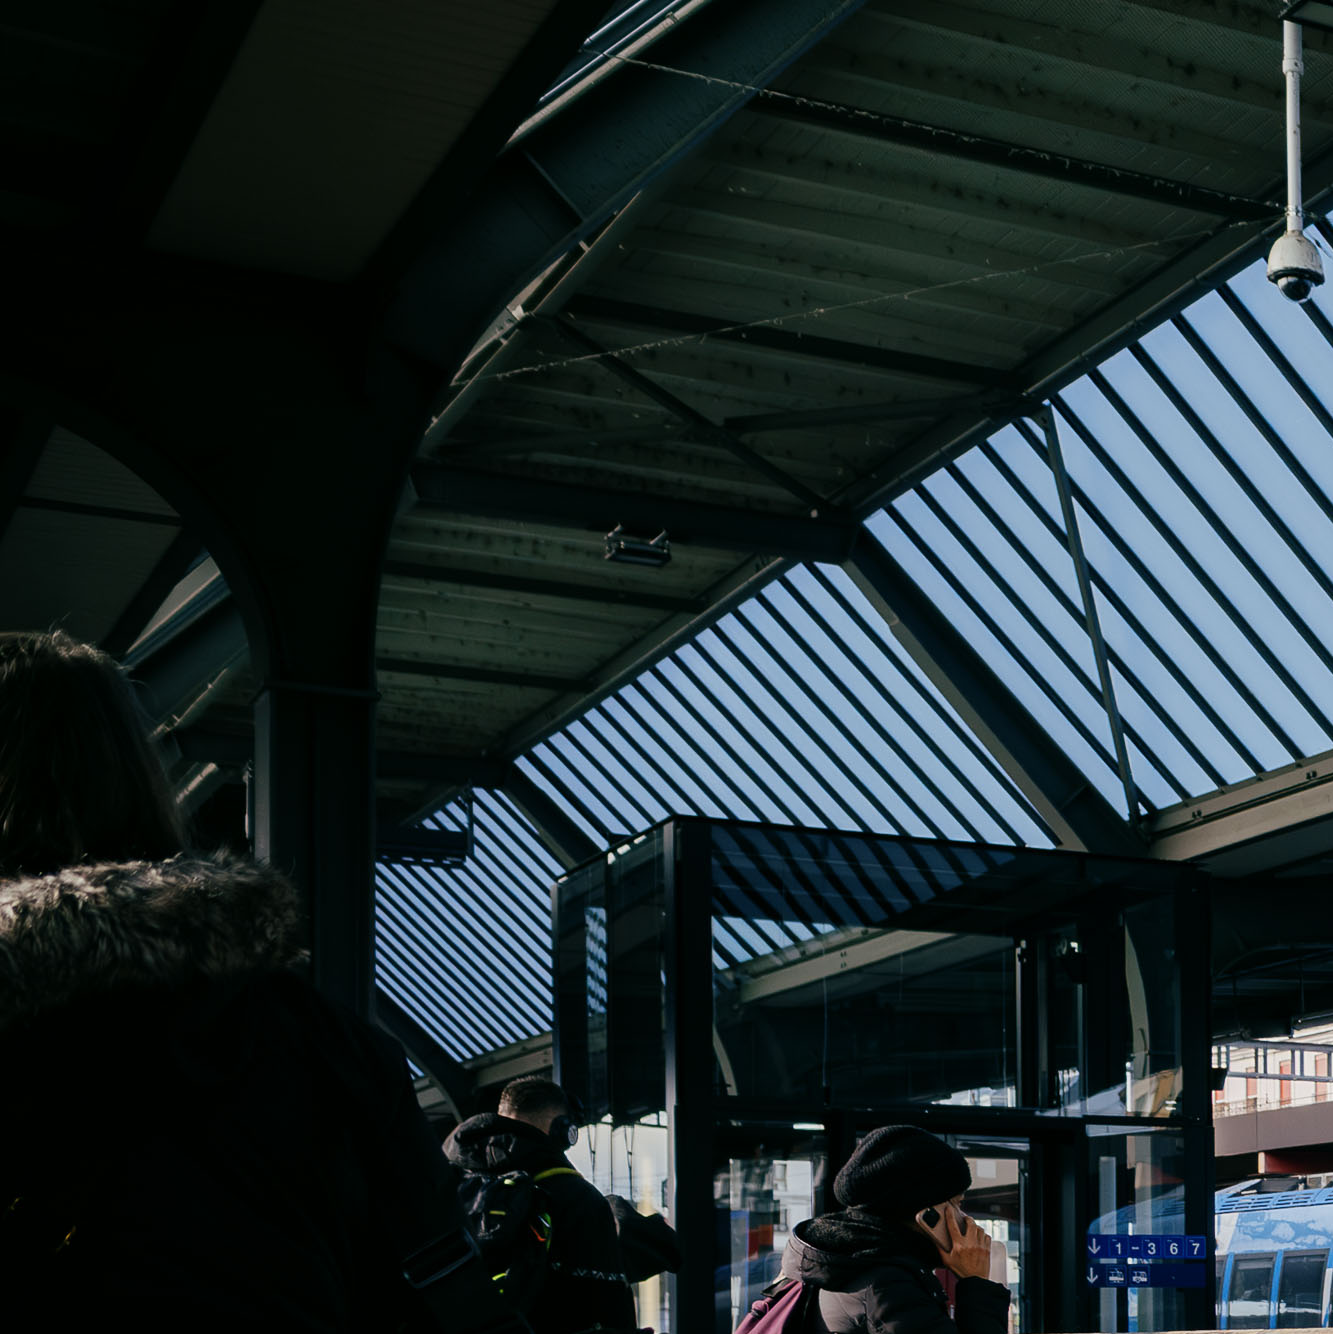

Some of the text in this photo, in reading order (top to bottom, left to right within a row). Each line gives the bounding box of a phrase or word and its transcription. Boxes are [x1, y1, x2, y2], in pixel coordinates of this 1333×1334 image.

[1115, 1242, 1121, 1255] 1
[1147, 1242, 1156, 1255] 3
[1169, 1242, 1179, 1255] 6
[1192, 1242, 1200, 1255] 7
